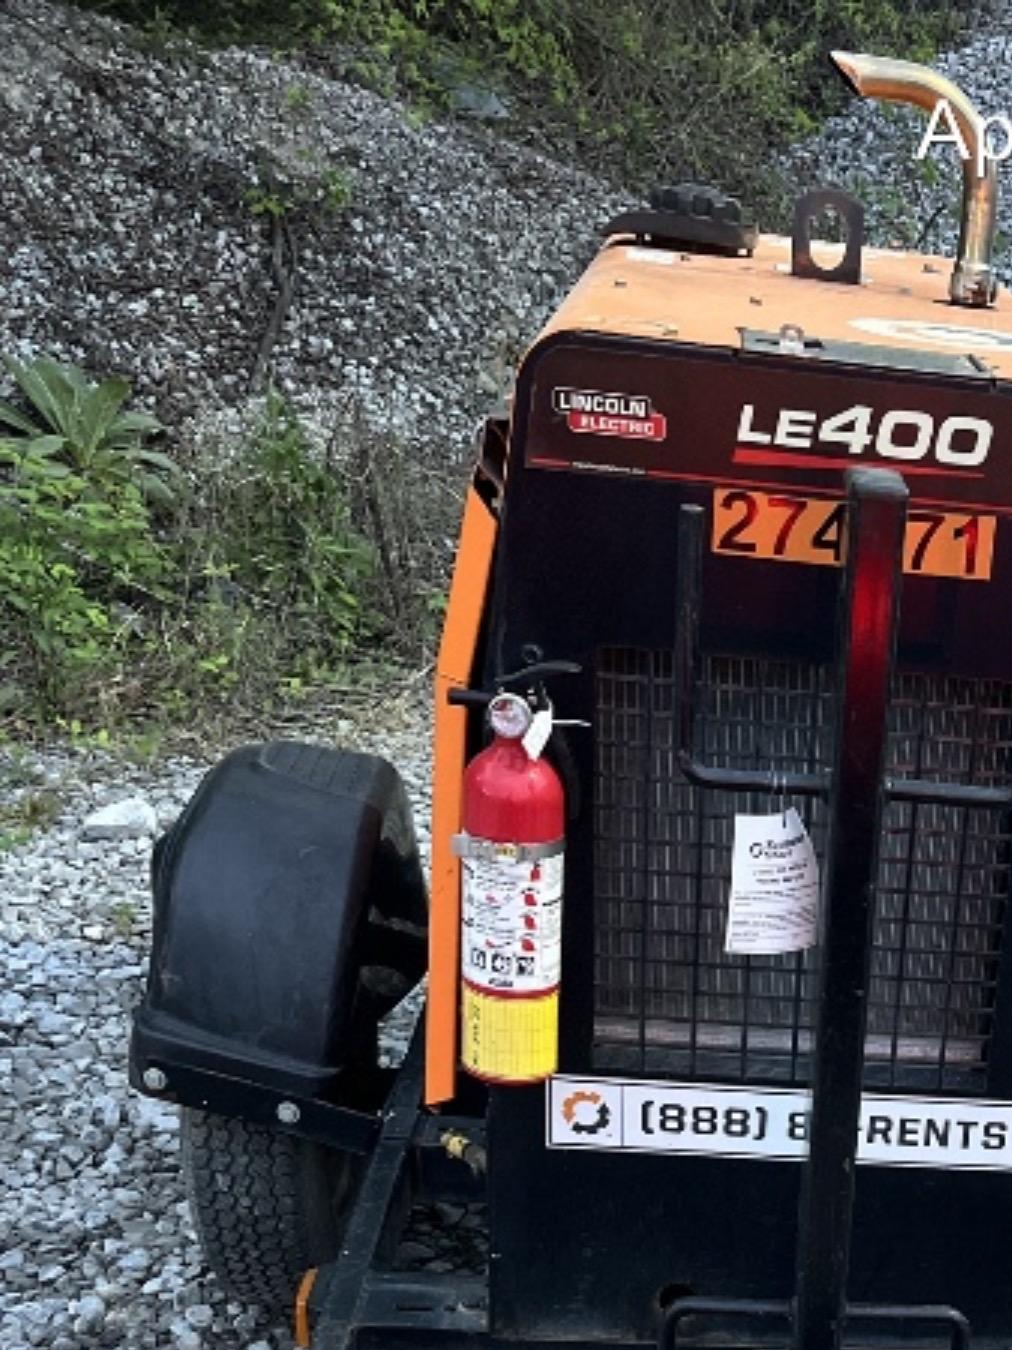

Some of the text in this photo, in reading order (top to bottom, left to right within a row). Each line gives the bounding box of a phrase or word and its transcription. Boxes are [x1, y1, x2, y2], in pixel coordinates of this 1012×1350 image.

[559, 391, 646, 417] LINCOLN
[580, 413, 656, 437] ELECTRIC
[735, 403, 995, 467] LE400
[716, 489, 981, 576] 27471
[640, 1099, 1008, 1150] (888) 8RENTS
